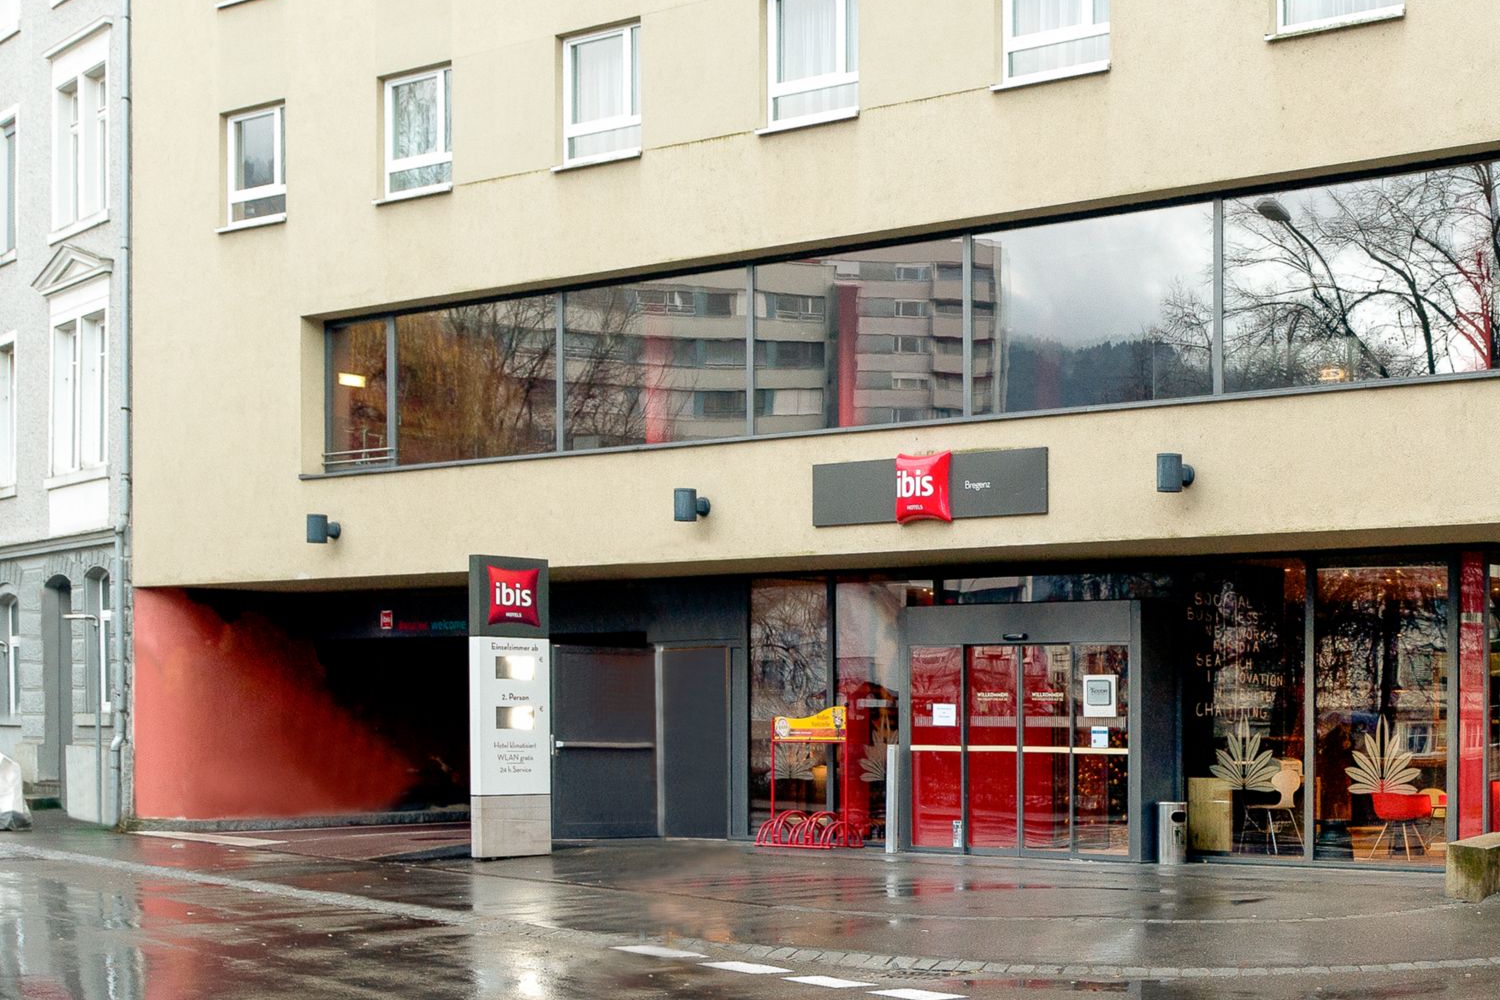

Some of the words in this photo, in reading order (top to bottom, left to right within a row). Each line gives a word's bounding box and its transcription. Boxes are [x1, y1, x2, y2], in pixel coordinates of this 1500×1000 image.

[896, 470, 934, 498] ibis
[964, 480, 991, 491] Bregenz
[495, 582, 532, 607] ibis
[1194, 592, 1253, 609] SOCAL
[1206, 625, 1267, 642] NEWORK
[491, 642, 530, 651] Einzelzimmer
[1196, 654, 1254, 670] SEACH
[508, 693, 530, 701] Person
[493, 741, 508, 749] Hotel
